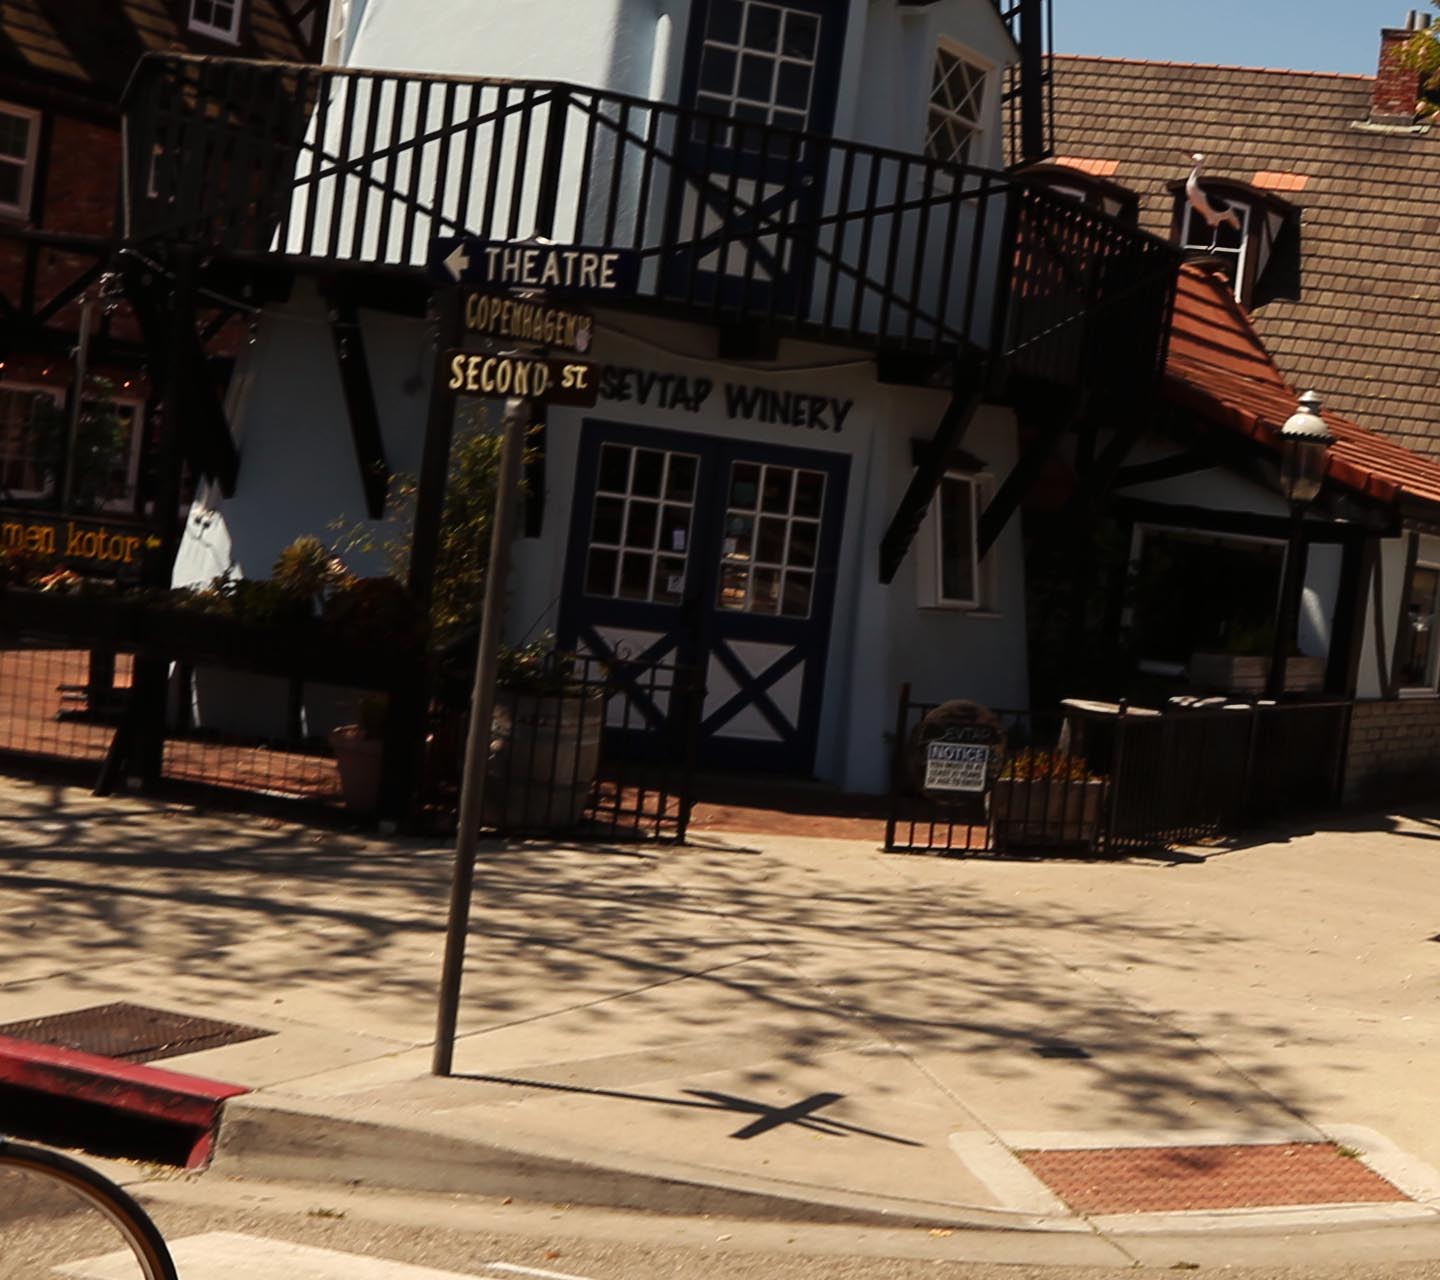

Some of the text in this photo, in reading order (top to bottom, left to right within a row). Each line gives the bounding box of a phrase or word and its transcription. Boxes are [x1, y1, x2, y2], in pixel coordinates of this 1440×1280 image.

[485, 246, 620, 289] THEATRE
[465, 291, 577, 346] COPENHAGEN
[448, 353, 550, 398] SECOND
[598, 363, 855, 434] SEVTAP WINERY
[930, 745, 986, 762] NOTICE
